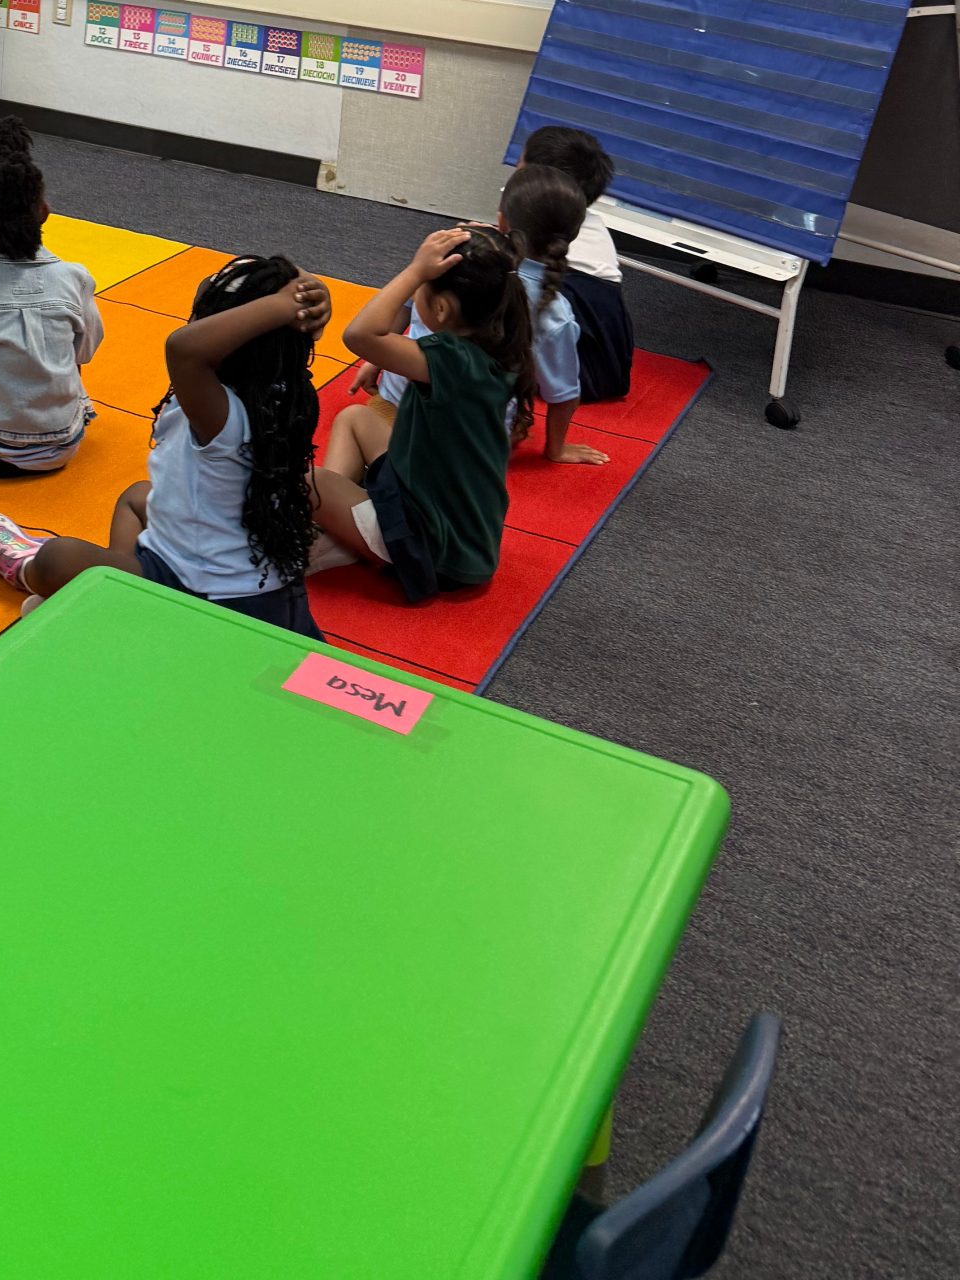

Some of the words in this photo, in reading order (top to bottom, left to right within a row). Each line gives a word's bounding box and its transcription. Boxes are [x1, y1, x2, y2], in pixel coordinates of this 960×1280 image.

[98, 27, 107, 35] 12
[90, 35, 113, 45] DOCE
[133, 32, 141, 40] 13
[123, 39, 149, 51] TRECE
[202, 44, 211, 52] 15
[191, 51, 220, 63] QUINCE
[240, 49, 248, 58] 16
[277, 55, 286, 64] 17
[315, 60, 325, 69] 18
[354, 66, 364, 75] 19
[394, 73, 407, 82] 20
[383, 81, 417, 94] VEINTE
[326, 675, 408, 717] Mesa
